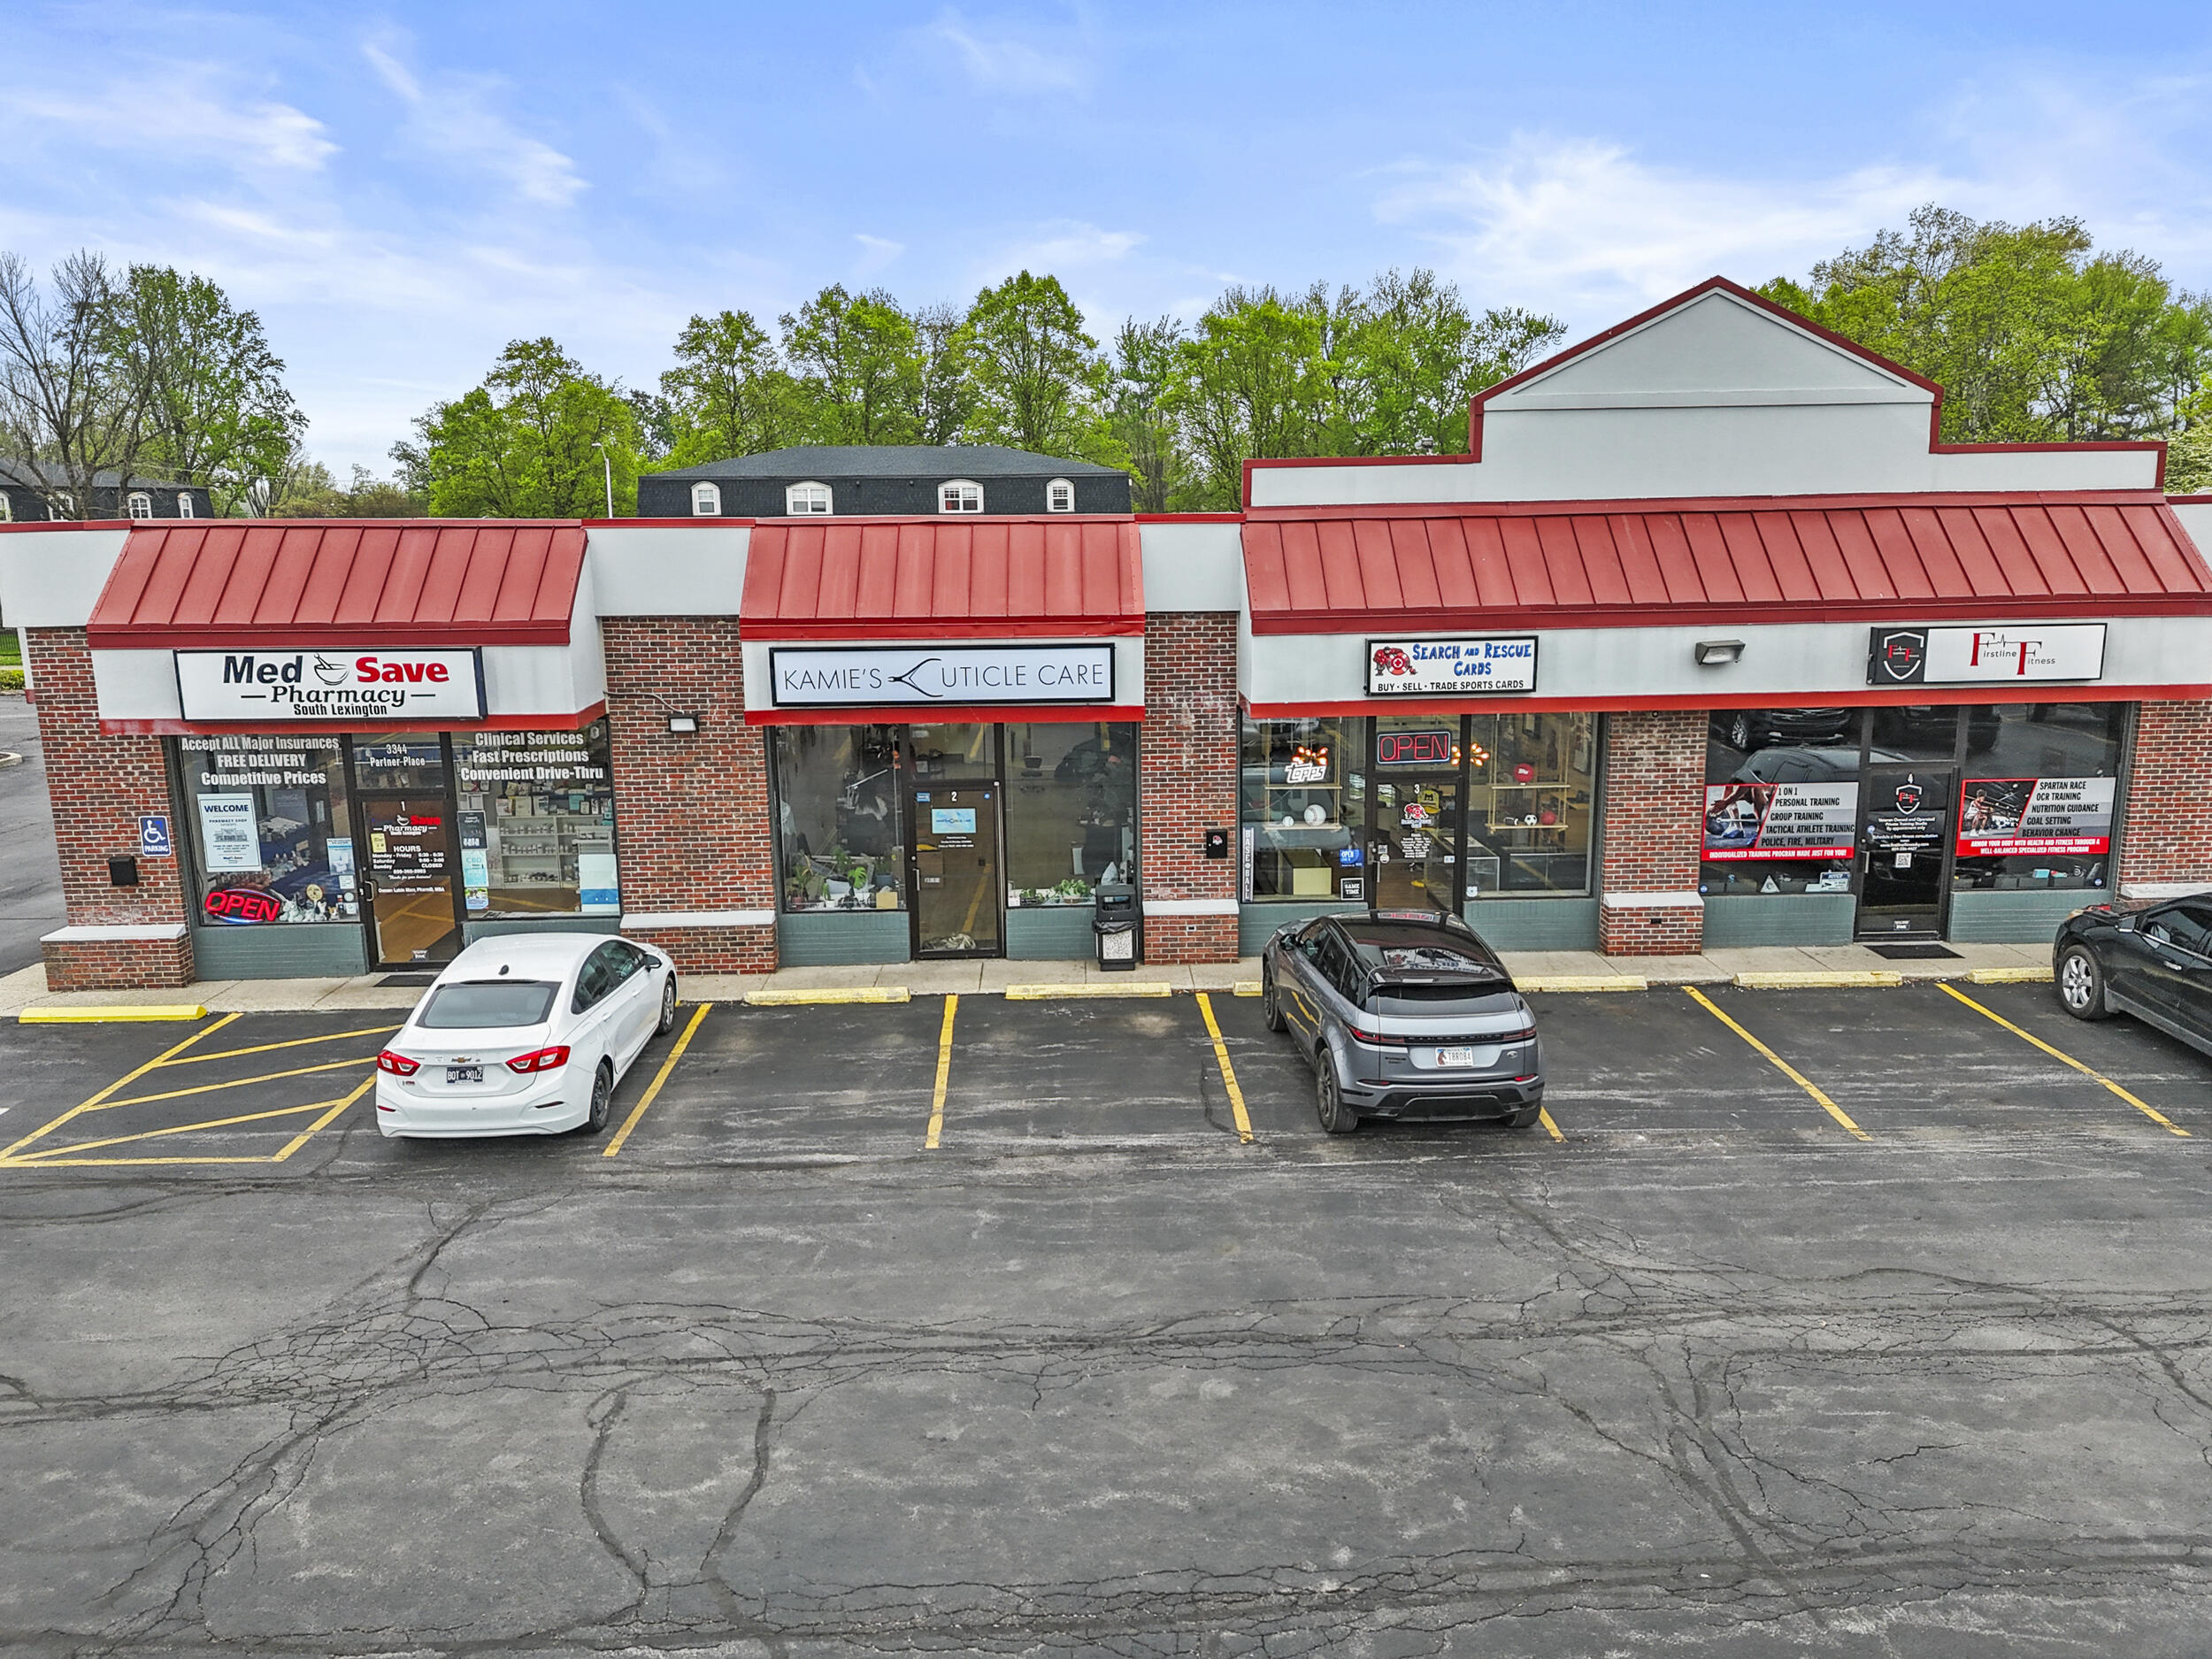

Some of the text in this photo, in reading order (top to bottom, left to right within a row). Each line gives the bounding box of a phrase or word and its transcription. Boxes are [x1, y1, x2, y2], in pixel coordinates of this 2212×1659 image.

[1412, 644, 1460, 660] SEARCH
[1484, 642, 1532, 658] RESCUE
[223, 656, 449, 684] Med Save
[1453, 661, 1492, 677] CARDS
[784, 668, 882, 690] KAMIE'S
[1038, 664, 1104, 686] CARE
[1378, 683, 1395, 692] BUY
[1430, 681, 1457, 690] TRADE
[1460, 680, 1493, 689] SPORTS
[1495, 680, 1525, 688] CARDS
[271, 685, 406, 708] Pharmacy
[293, 703, 388, 718] South Lexington
[181, 736, 339, 751] Accept ALL Major Insurances
[474, 732, 584, 746] Clinical Services
[386, 744, 407, 755] 3344
[1379, 735, 1448, 762] OPEN
[217, 754, 307, 768] FREE DELIVERY
[370, 757, 425, 767] Partner Place
[472, 749, 589, 764] Fast Prescriptions
[201, 771, 326, 786] Competitive Prices
[460, 766, 603, 780] Convenient Drive-Thru
[1414, 784, 1420, 794] 3
[2039, 781, 2069, 790] SPARTAN
[951, 791, 957, 802] 2
[1775, 797, 1840, 807] PERSONAL TRAINING
[2051, 792, 2081, 801] TRAINING
[401, 801, 406, 811] 1
[2032, 803, 2100, 813] NUTRITION GUIDANCE
[410, 815, 442, 826] Save
[1770, 811, 1824, 821] GROUP TRAINING
[2045, 816, 2071, 825] SETTING
[383, 824, 428, 833] Pharmacy
[1824, 824, 1855, 833] TRAINING
[2022, 827, 2081, 837] BEHAVIOR CHANGE
[1761, 836, 1834, 847] POLICE, FIRE, MILITARY
[204, 890, 281, 922] OPEN
[465, 1070, 483, 1079] 9012
